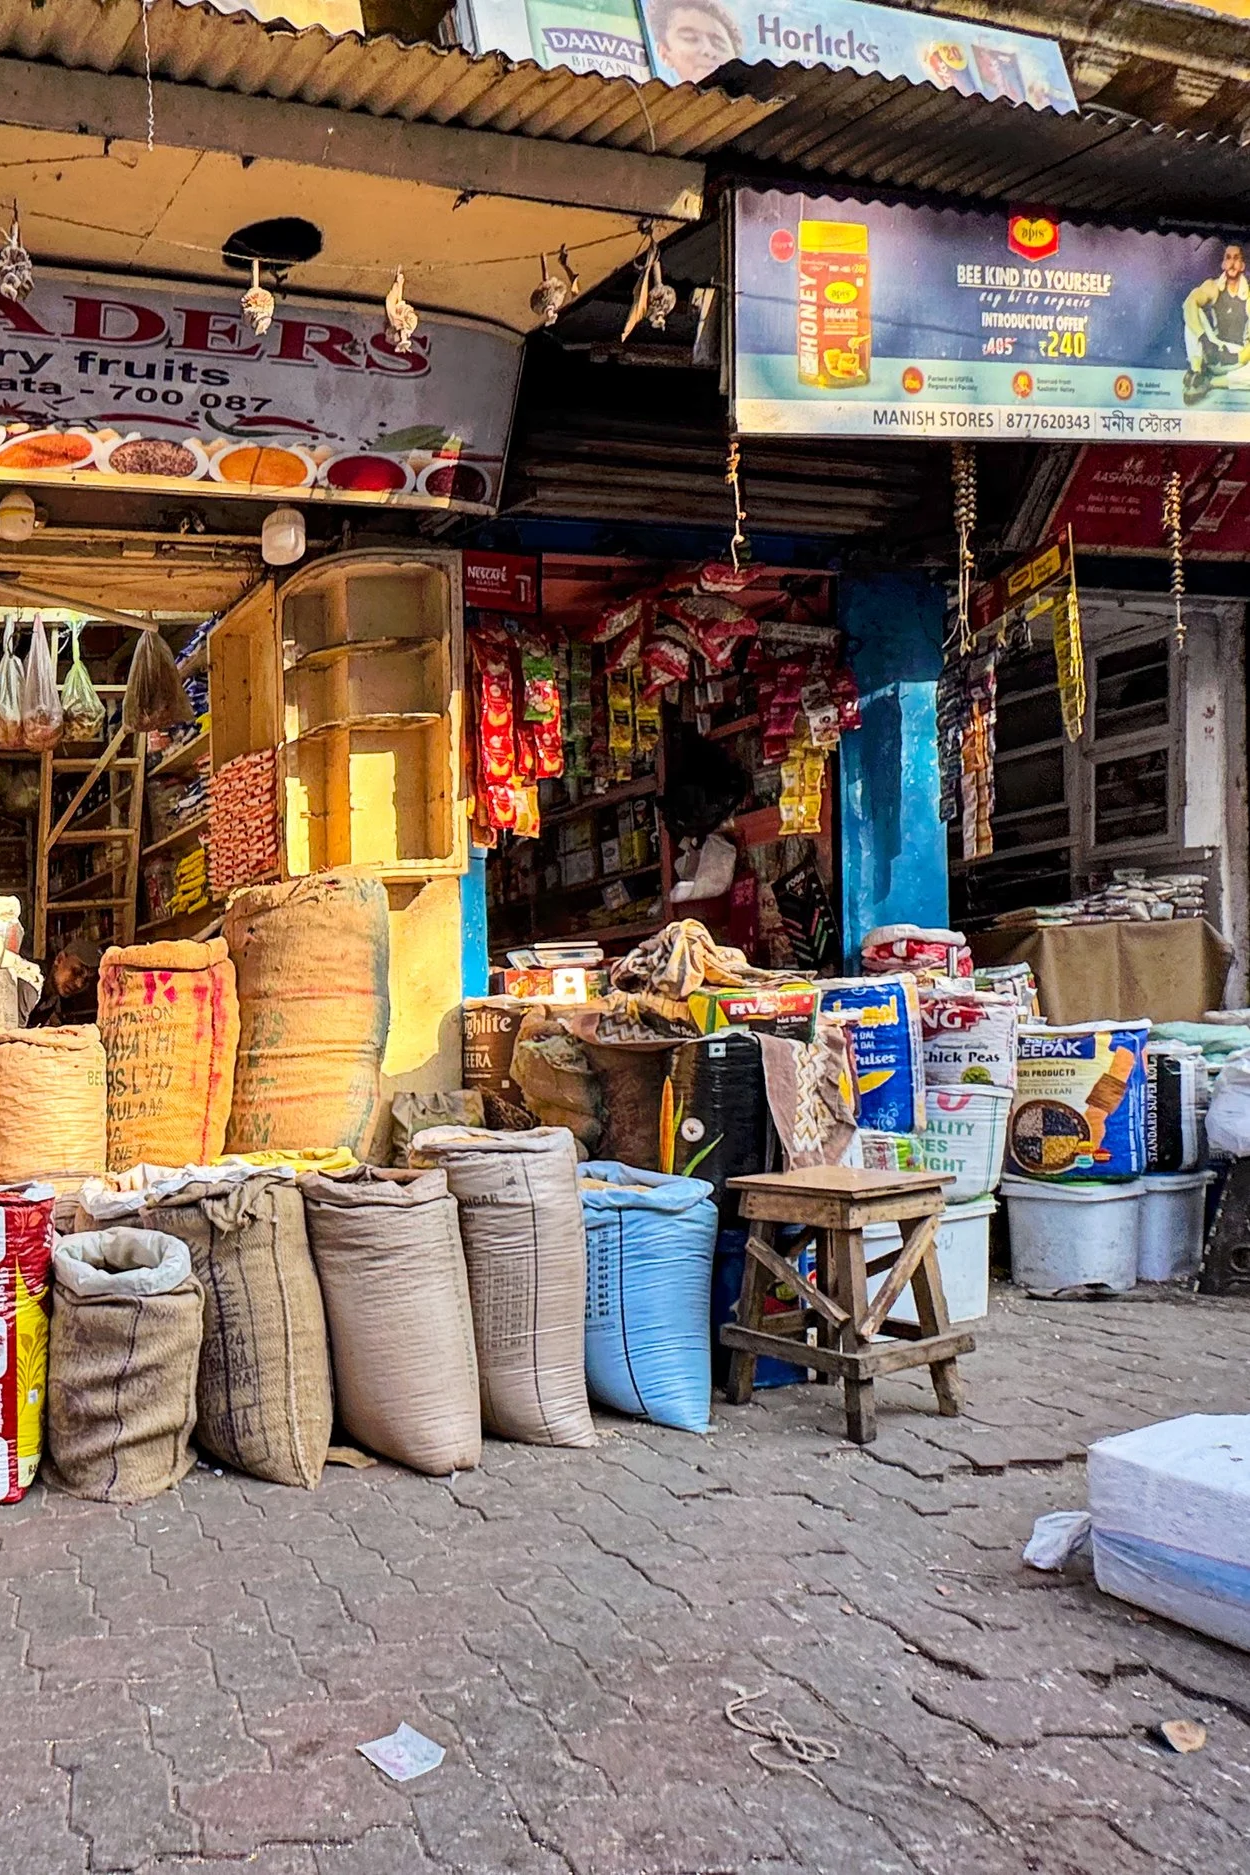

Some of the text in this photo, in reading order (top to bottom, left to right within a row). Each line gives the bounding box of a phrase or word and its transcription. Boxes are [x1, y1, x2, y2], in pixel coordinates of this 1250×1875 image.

[548, 31, 645, 64] DAAWAT
[758, 14, 881, 64] Horlicks
[957, 265, 1112, 293] BEE KIND TO YOURSELF
[799, 273, 818, 354] HONEY
[981, 312, 1054, 330] INTRODUCTORY
[74, 351, 230, 387] fruits
[109, 384, 184, 406] 700
[199, 392, 272, 413] 087
[873, 409, 1091, 431] MANISH STORES 8777620343
[968, 1051, 1001, 1063] Peas
[1032, 1068, 1076, 1078] PRODUCTS
[1045, 1087, 1072, 1095] CLEAN
[1147, 1082, 1158, 1111] SUPER
[1147, 1112, 1158, 1162] STANDARD
